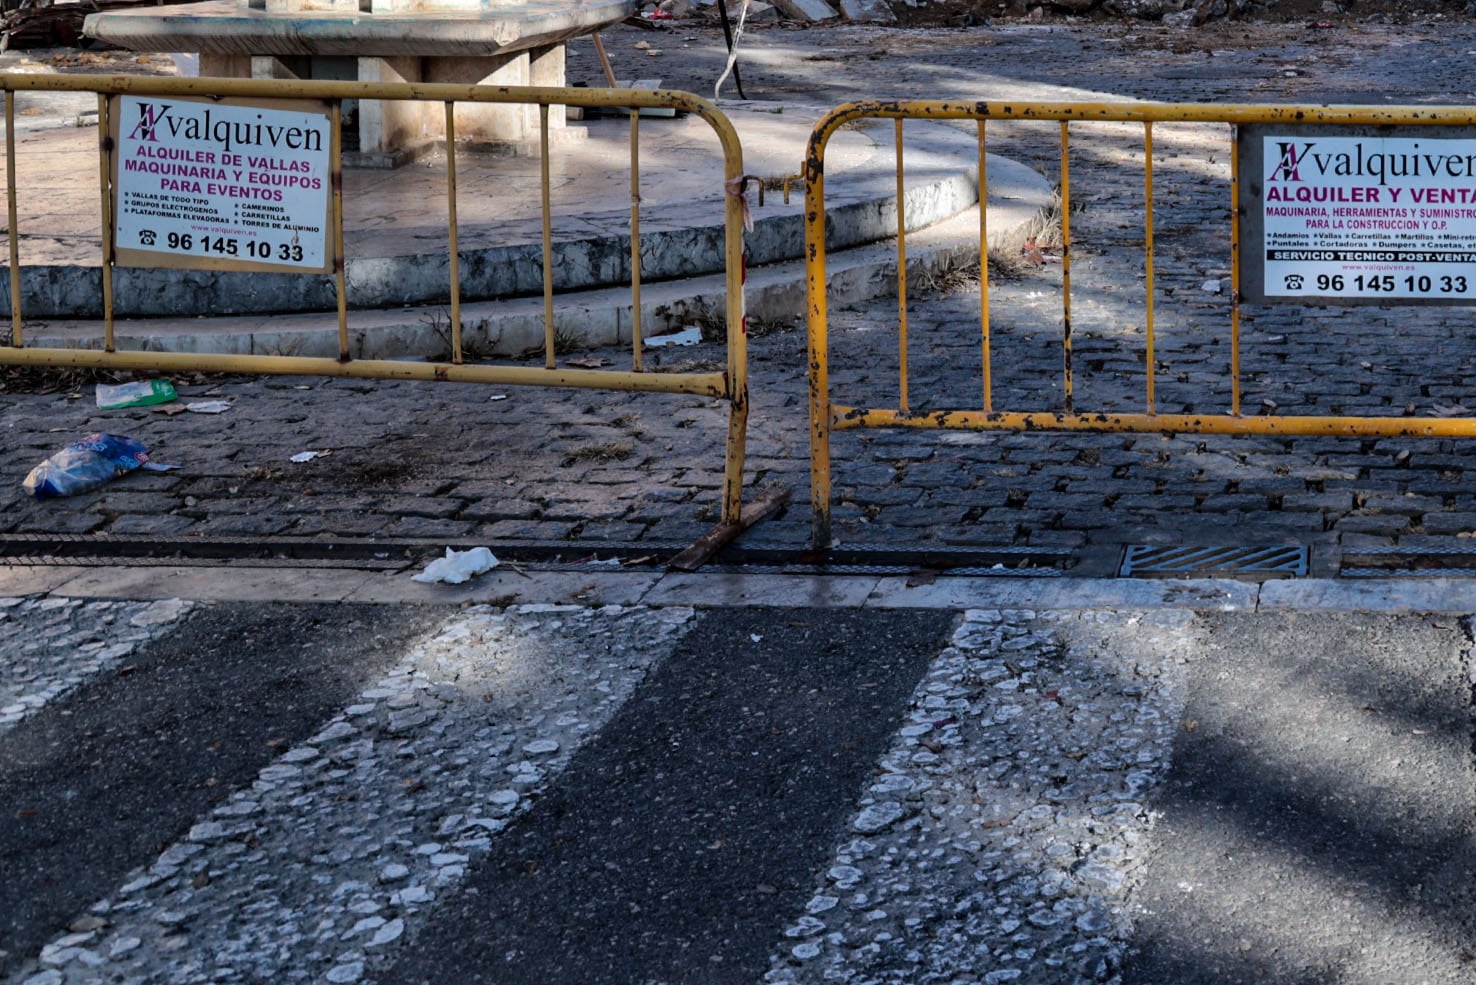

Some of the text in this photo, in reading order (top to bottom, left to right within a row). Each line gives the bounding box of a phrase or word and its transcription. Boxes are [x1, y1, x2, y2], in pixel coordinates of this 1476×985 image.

[165, 109, 322, 152] valquiven
[136, 145, 310, 173] ALQUILER DE VALLAS
[125, 159, 321, 190] MAQUINARIA Y EQUIPOS
[161, 178, 283, 202] PARA EVENTOS
[1266, 186, 1380, 203] ALQUILER
[1388, 188, 1402, 202] Y
[131, 191, 158, 200] VALLAS
[171, 196, 190, 204] TODO
[131, 200, 159, 208] GRUPOS
[241, 203, 285, 213] CAMERINOS
[1266, 207, 1330, 218] MAQUINARIA,
[1333, 207, 1408, 218] HERRAMIENTAS
[1411, 208, 1417, 217] Y
[131, 208, 230, 224] PLATAFORMAS ELEVADORAS
[241, 211, 290, 222] CARRETILLAS
[191, 224, 257, 236] www.valquiven.es
[242, 219, 320, 233] TORRES DE ALUMINIO
[1306, 219, 1448, 230] PARA LA CONSTRUCCION Y O.P.
[167, 232, 303, 262] 96 145 10 33
[1274, 251, 1335, 260] SERVICIO
[1338, 252, 1395, 261] TECNICO
[1342, 264, 1415, 272] www.valquiven.es
[1317, 274, 1468, 293] 96 145 10 33
